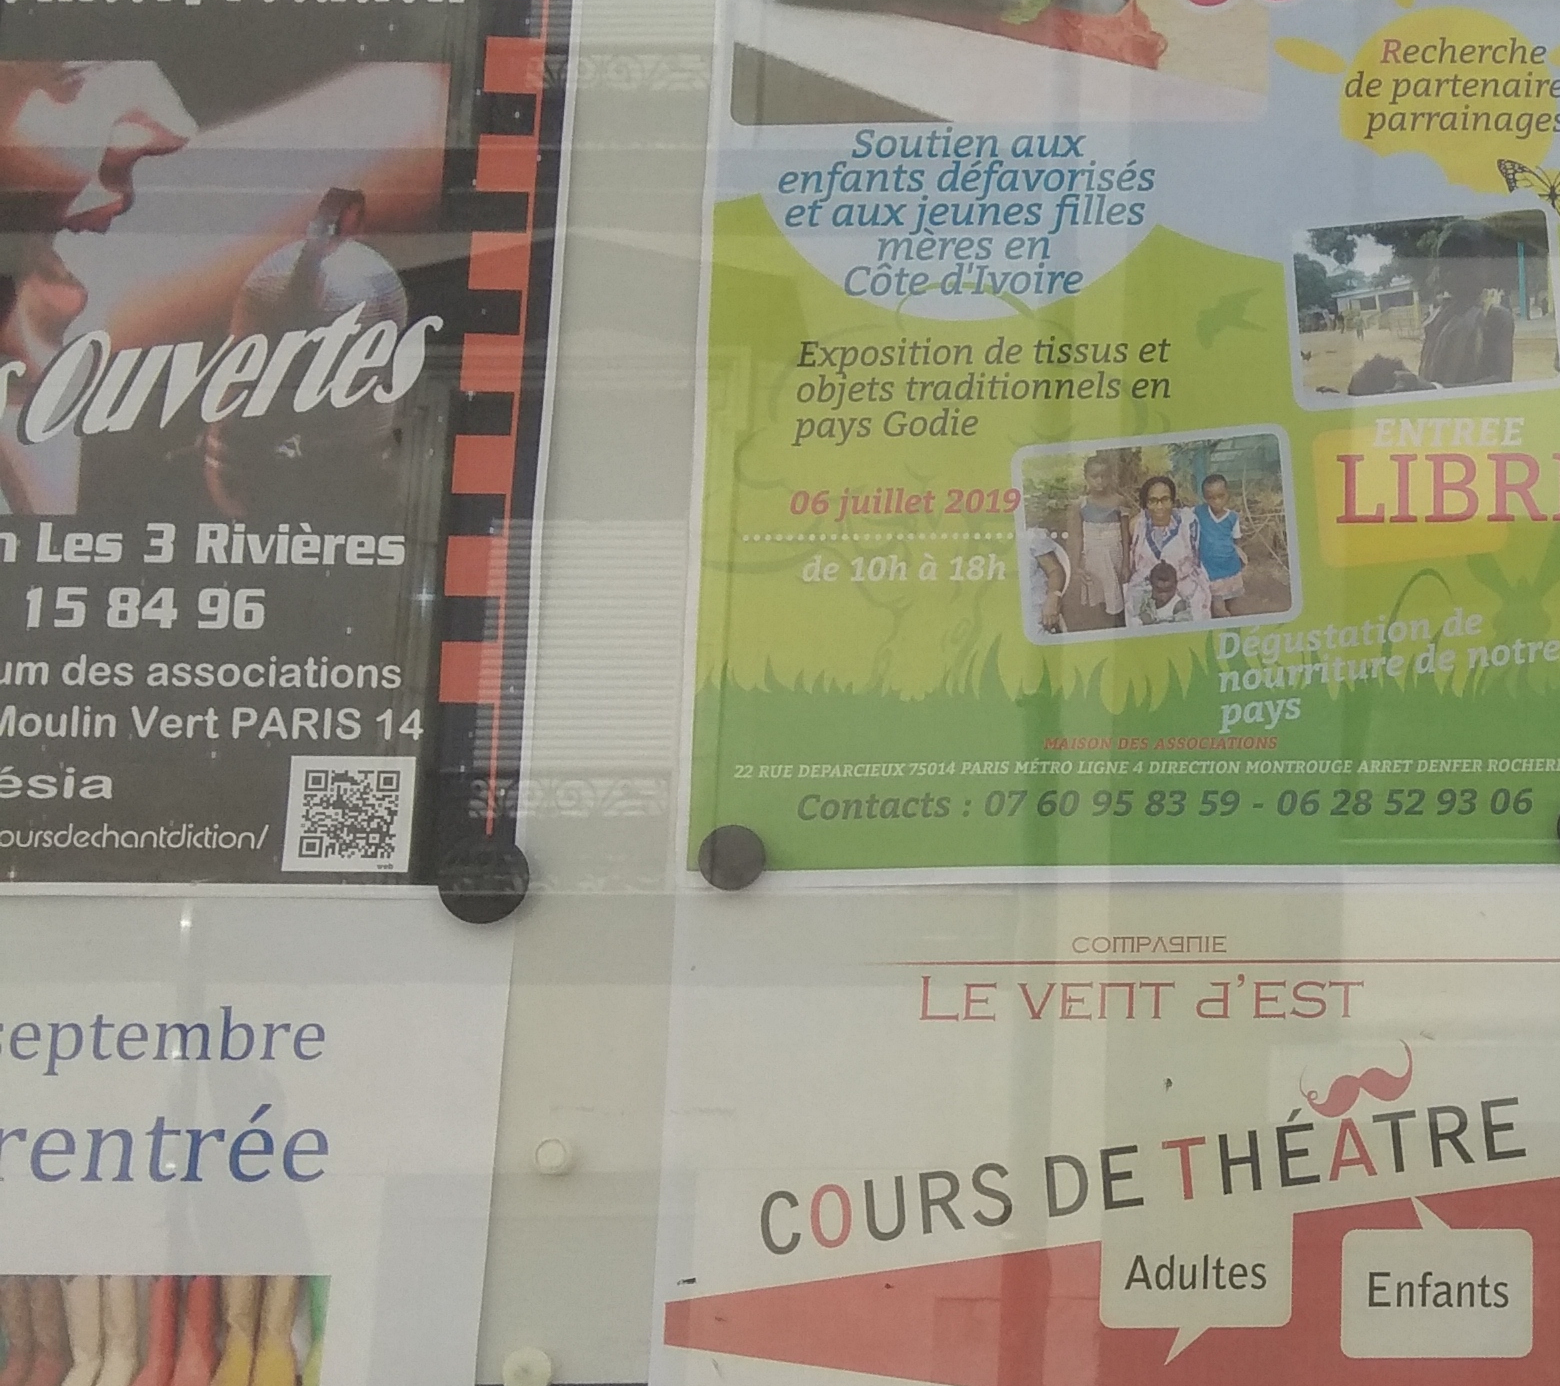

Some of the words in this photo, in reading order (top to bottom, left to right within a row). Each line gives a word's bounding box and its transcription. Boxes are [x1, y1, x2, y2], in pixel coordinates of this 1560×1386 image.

[1380, 37, 1547, 66] Recherche
[852, 126, 999, 159] Soutien
[1010, 133, 1086, 158] aux
[778, 161, 925, 202] enfants
[937, 159, 1155, 201] défavorisés
[832, 202, 906, 227] aux
[912, 196, 1042, 234] jeunes
[1051, 194, 1145, 234] filles
[877, 228, 992, 262] mères
[844, 265, 929, 297] Côte
[940, 263, 1084, 296] d'Ivoire
[19, 300, 444, 445] Ouvertes
[797, 337, 974, 374] Exposition
[1034, 336, 1128, 365] tissus
[796, 374, 895, 410] objets
[906, 372, 1121, 402] traditionnels
[792, 415, 872, 446] pays
[883, 409, 979, 439] Godie
[1373, 417, 1525, 449] ENTREE
[835, 487, 936, 522] juillet
[944, 488, 1021, 515] 2019
[36, 522, 123, 564] Les
[195, 522, 406, 566] Rivières
[851, 555, 908, 582] 10h
[1216, 613, 1432, 661] Dégustation
[61, 655, 135, 687] des
[146, 656, 402, 689] associations
[1218, 647, 1404, 695] nourriture
[131, 705, 218, 740] Vert
[232, 707, 362, 741] PARIS
[1218, 695, 1302, 733] pays
[797, 762, 907, 778] DEPARCIEUX
[1246, 759, 1352, 775] MONTROUGE
[797, 792, 951, 822] Contacts
[1071, 934, 1228, 955] COMPAGNIE
[0, 1103, 329, 1182] rentrée
[761, 1162, 1013, 1255] COURS
[1044, 1144, 1145, 1219] DE
[1124, 1255, 1269, 1292] Adultes
[1365, 1271, 1511, 1310] Enfants
